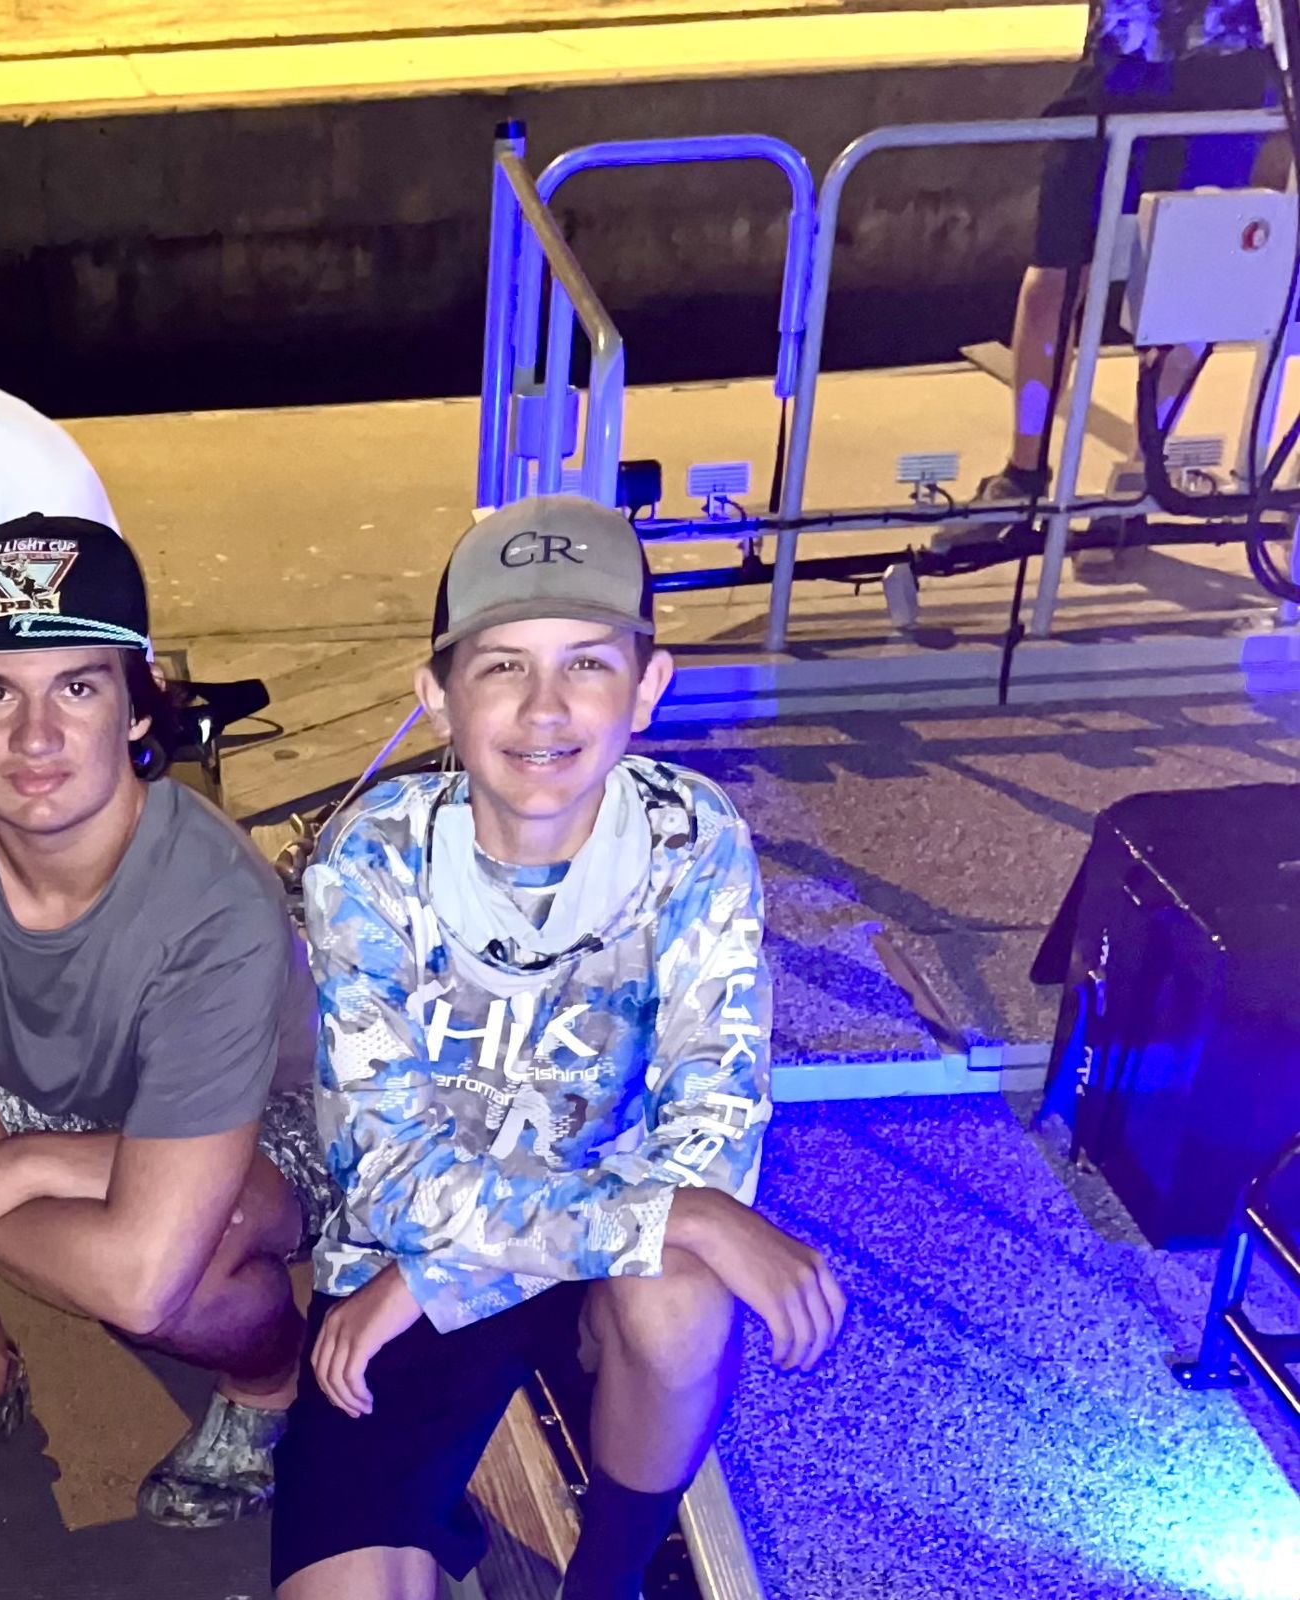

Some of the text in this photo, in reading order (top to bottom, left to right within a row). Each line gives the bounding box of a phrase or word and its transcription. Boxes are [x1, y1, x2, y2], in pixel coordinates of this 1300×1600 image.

[3, 538, 46, 552] LIGHT
[48, 540, 76, 551] CUP
[500, 531, 584, 568] CR
[0, 598, 54, 613] PBR
